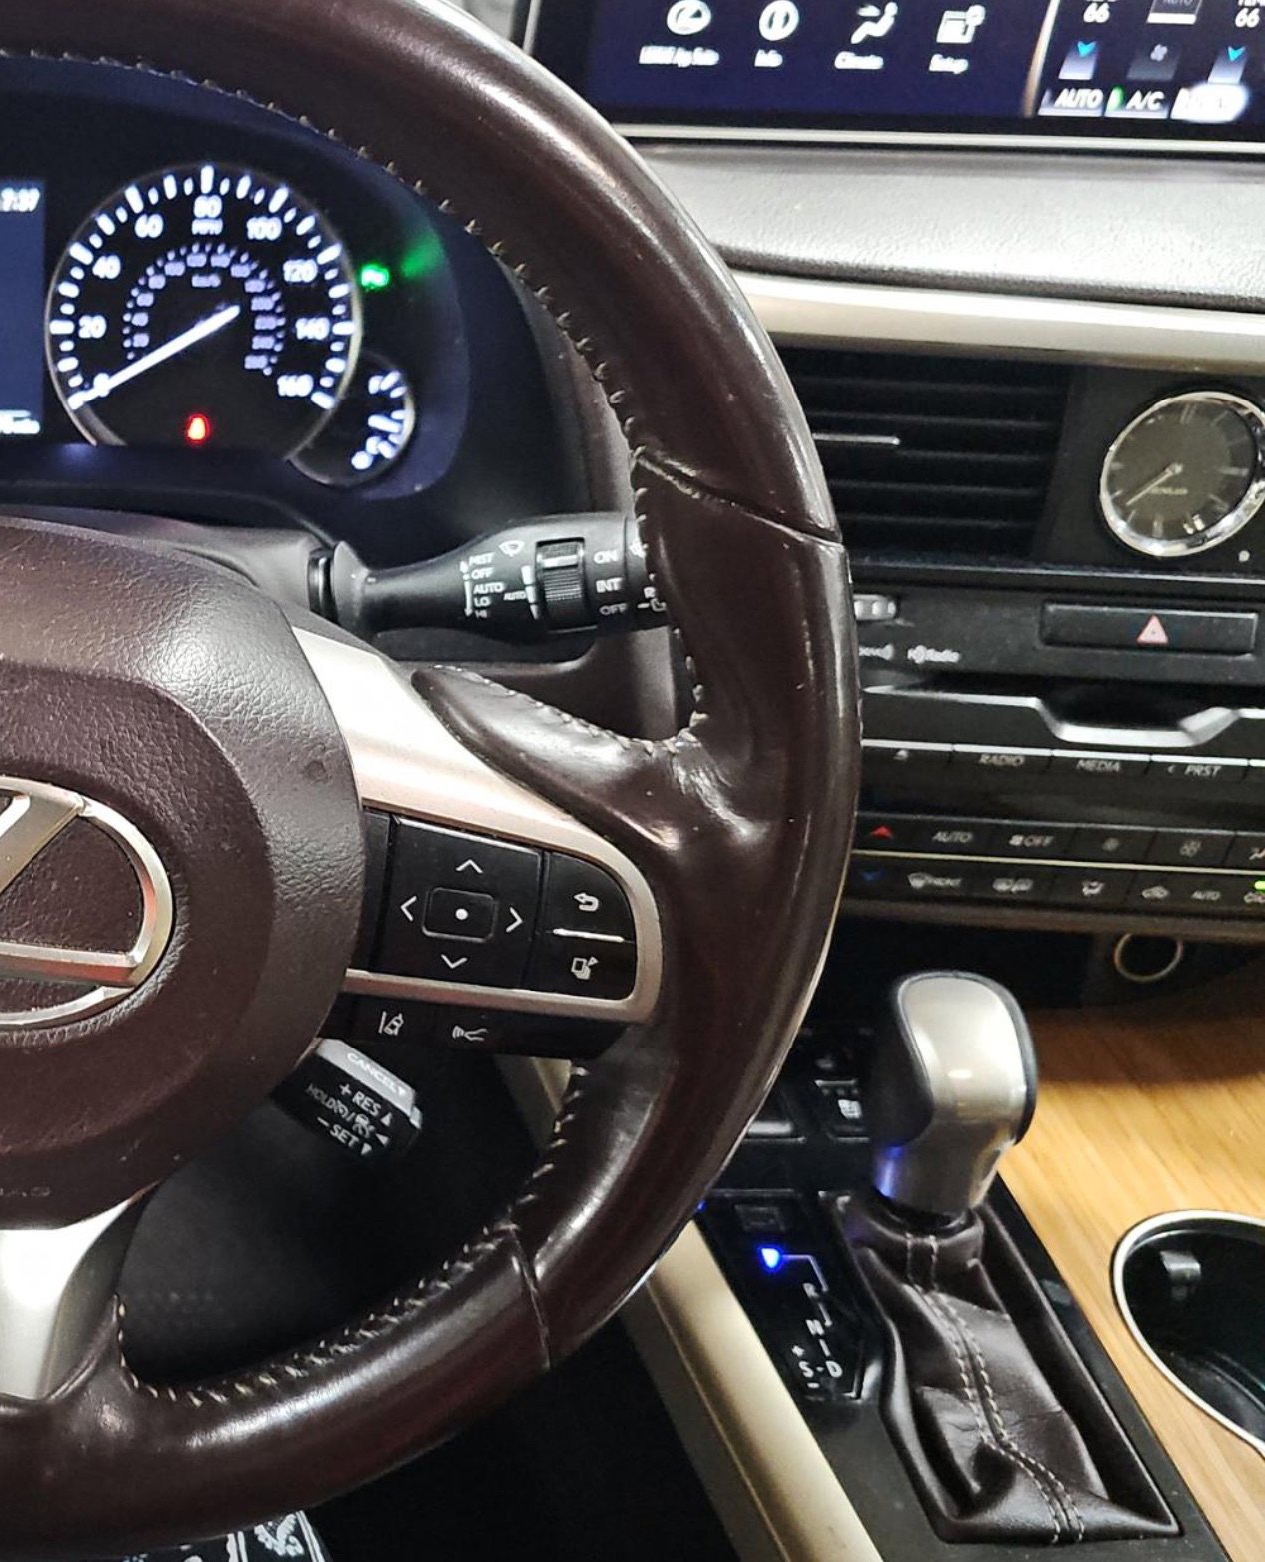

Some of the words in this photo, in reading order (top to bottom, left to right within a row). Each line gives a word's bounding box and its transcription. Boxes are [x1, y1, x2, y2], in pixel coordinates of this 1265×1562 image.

[1083, 3, 1111, 23] 66
[1235, 8, 1260, 28] 66
[1054, 88, 1103, 109] AUTO
[1126, 90, 1165, 110] A/C
[193, 195, 222, 217] 80
[135, 214, 163, 238] 60
[247, 216, 282, 240] 100
[92, 254, 121, 279] 40
[283, 259, 317, 282] 120
[78, 315, 106, 339] 20
[295, 317, 330, 340] 140
[277, 374, 313, 397] 160
[469, 552, 494, 567] MIST
[593, 550, 618, 564] ON
[471, 568, 494, 579] OFF
[473, 582, 504, 595] AUTO
[596, 577, 623, 593] INT
[474, 596, 491, 607] LO
[503, 590, 526, 600] AUTO
[475, 610, 488, 619] HI
[599, 603, 627, 616] OFF
[978, 753, 1026, 768] RADIO
[1076, 758, 1121, 773] MEDIA
[1184, 764, 1222, 777] PRST
[932, 831, 974, 845] AUTO
[1023, 835, 1054, 847] OFF
[1191, 890, 1221, 901] AUTO
[347, 1052, 400, 1095] CANCEL
[305, 1083, 337, 1110] HOLD
[798, 1361, 814, 1378] S
[825, 1360, 843, 1378] D
